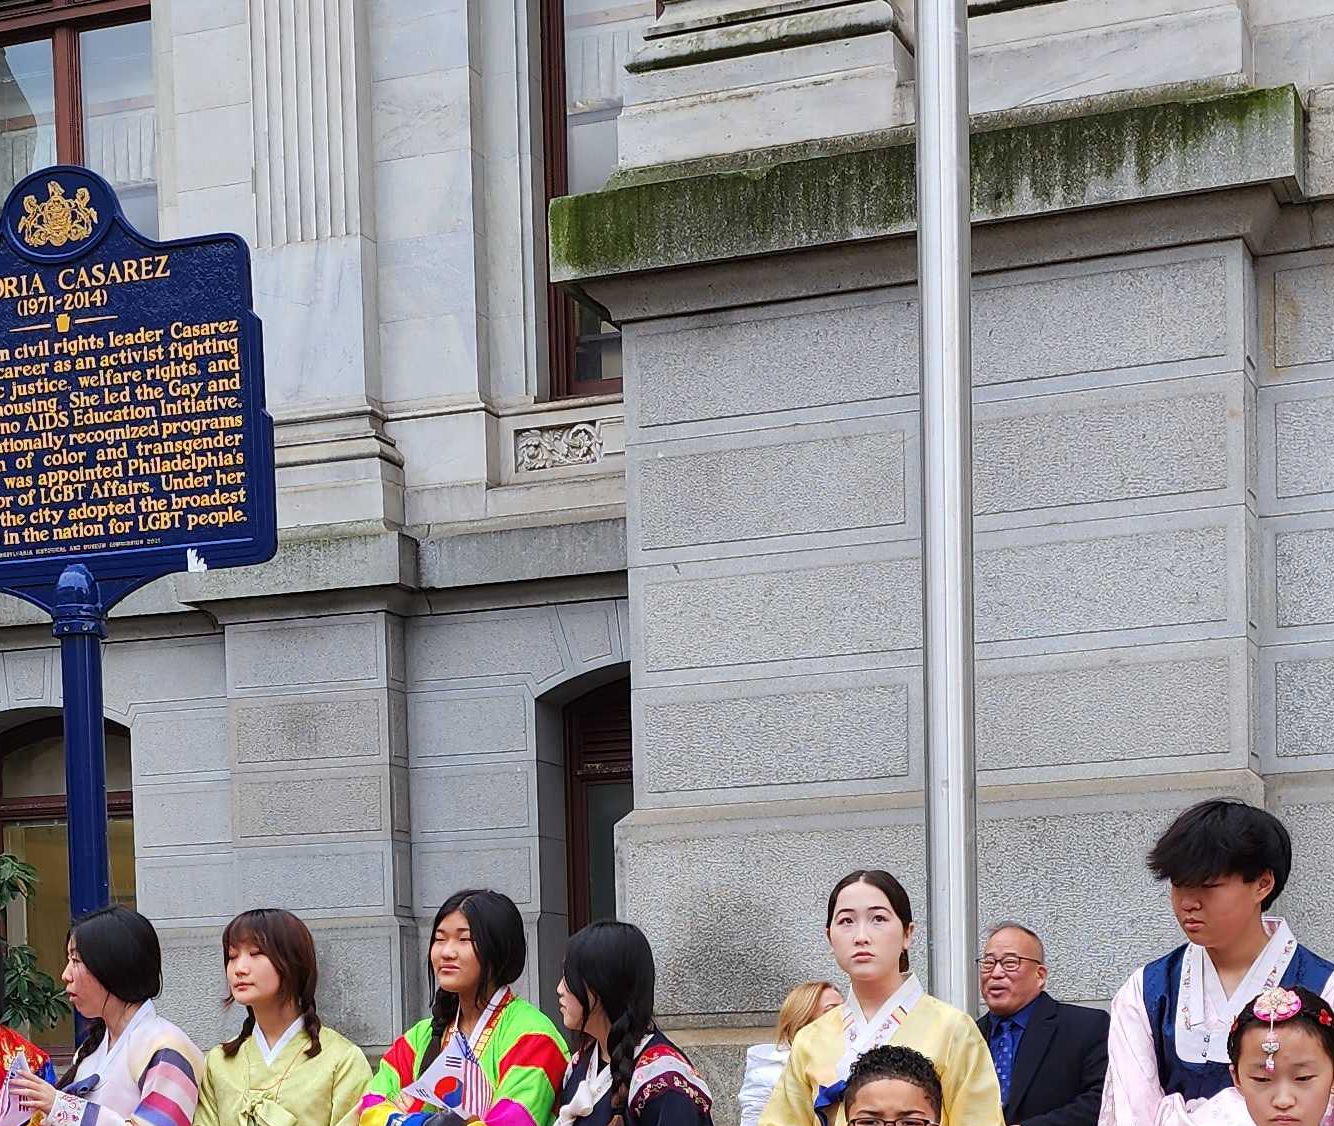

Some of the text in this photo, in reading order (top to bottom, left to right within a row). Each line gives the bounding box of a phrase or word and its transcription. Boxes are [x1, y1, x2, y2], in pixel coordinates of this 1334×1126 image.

[57, 254, 171, 290] CASAREZ
[17, 288, 108, 317] (1971-2014)
[14, 339, 50, 360] civil
[53, 333, 105, 357] rights
[108, 327, 163, 348] leader
[170, 320, 239, 340] Casarez
[53, 359, 72, 373] as
[74, 356, 97, 371] an
[99, 344, 165, 368] activist
[167, 337, 239, 364] fighting
[77, 370, 142, 389] welfare
[207, 355, 240, 373] and
[69, 391, 100, 409] She
[103, 386, 131, 405] led
[134, 383, 164, 401] the
[168, 380, 204, 401] Gay
[207, 373, 241, 393] and
[24, 411, 69, 432] AIDS
[72, 404, 157, 427] Education
[68, 420, 159, 446] recognized
[161, 415, 243, 439] programs
[15, 452, 35, 470] of
[42, 448, 87, 467] color
[95, 442, 129, 461] and
[134, 431, 244, 458] transgender
[3, 475, 33, 489] was
[37, 460, 124, 490] appointed
[127, 448, 244, 477] Philadelphia's
[17, 488, 37, 507] of
[39, 482, 87, 505] LGBT
[89, 479, 154, 499] Affairs.
[160, 471, 213, 491] Under
[215, 469, 246, 486] her
[28, 507, 64, 528] city
[67, 497, 136, 523] adopted
[138, 495, 168, 513] the
[170, 486, 247, 510] broadest
[3, 529, 20, 545] in
[21, 526, 50, 543] the
[52, 520, 105, 541] nation
[107, 517, 134, 535] for
[137, 511, 184, 532] LGBT
[186, 506, 248, 531] people.
